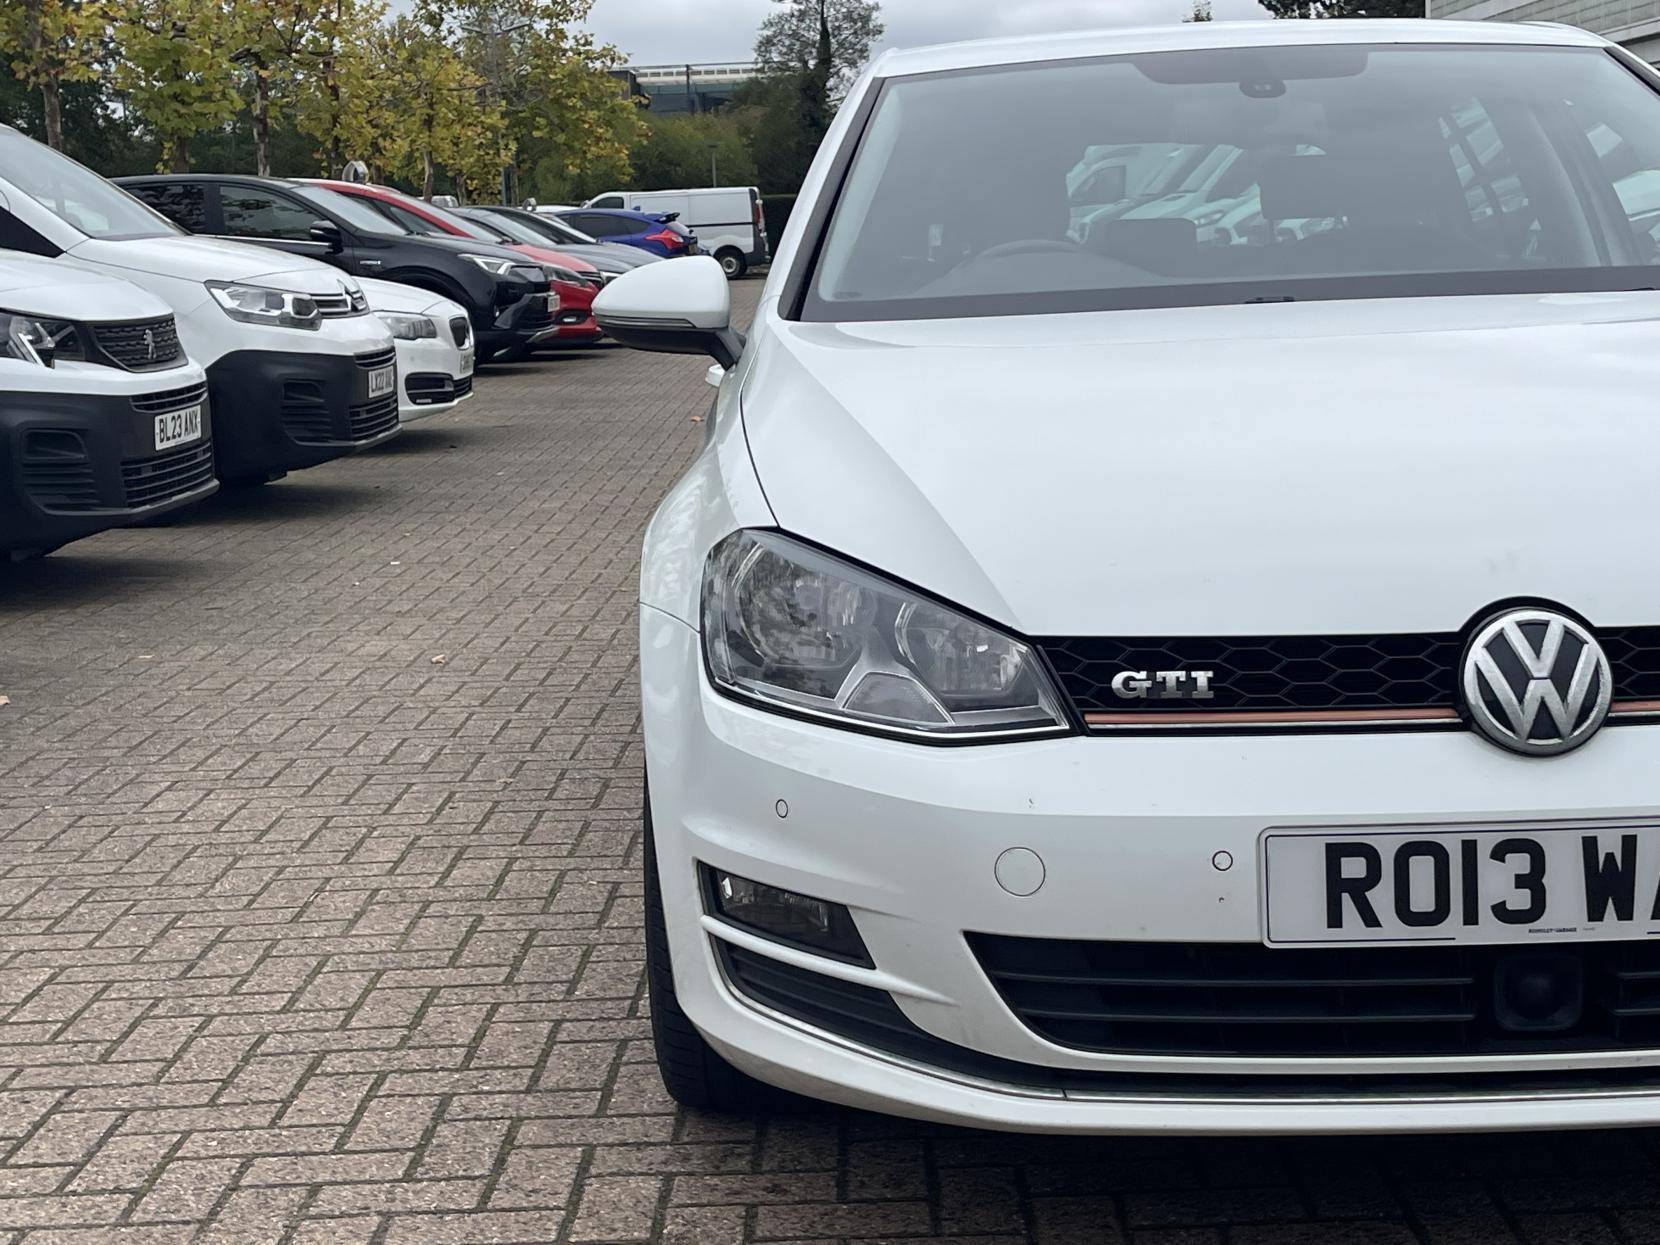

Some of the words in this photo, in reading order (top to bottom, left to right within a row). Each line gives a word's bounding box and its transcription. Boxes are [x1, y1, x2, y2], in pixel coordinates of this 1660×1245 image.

[159, 414, 182, 443] BL23
[184, 409, 199, 437] ANX
[1111, 670, 1214, 698] GTI
[1467, 611, 1611, 750] VW
[1325, 838, 1547, 928] RO13
[1581, 834, 1660, 922] W
